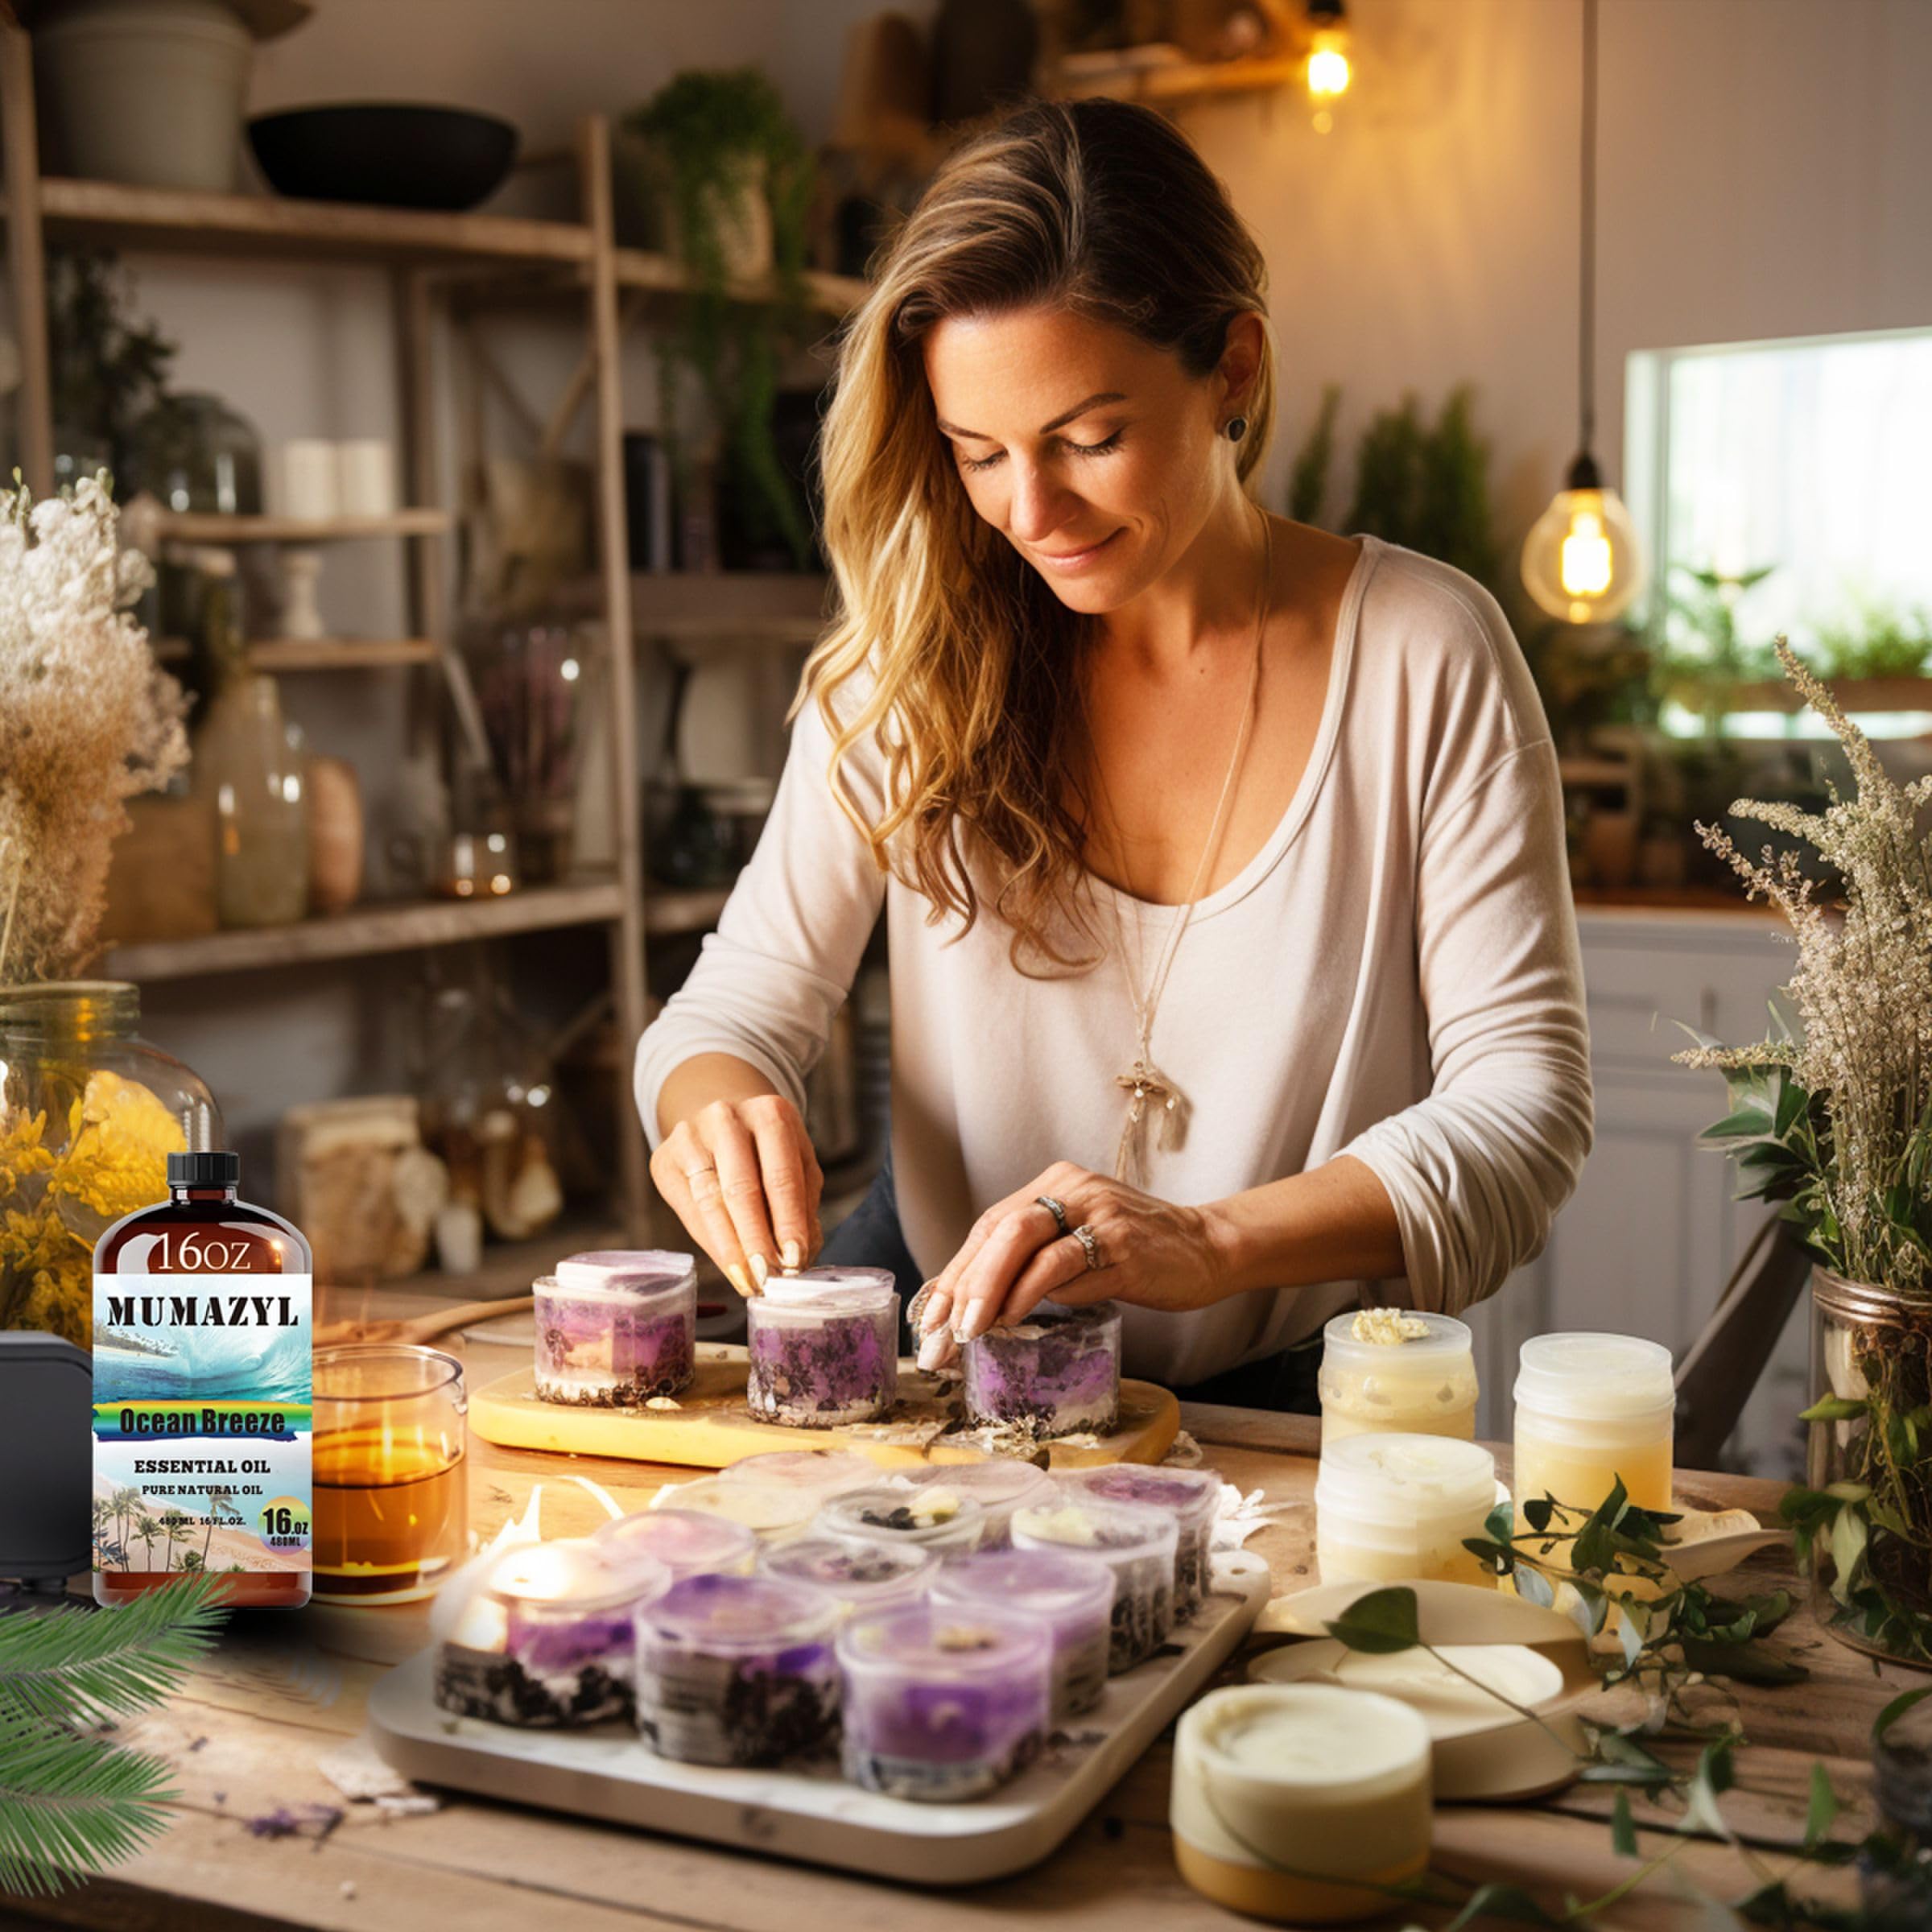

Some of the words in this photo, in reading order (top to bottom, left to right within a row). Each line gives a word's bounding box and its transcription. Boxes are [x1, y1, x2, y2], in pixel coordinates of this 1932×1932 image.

[107, 1296, 298, 1327] MUMAZYL
[119, 1408, 197, 1434] Ocean
[201, 1408, 285, 1435] Breeze
[134, 1459, 237, 1474] ESSENTIAL
[241, 1459, 271, 1474] OIL
[142, 1484, 175, 1495] PURE
[177, 1484, 240, 1495] NATURAL
[242, 1484, 263, 1495] OIL
